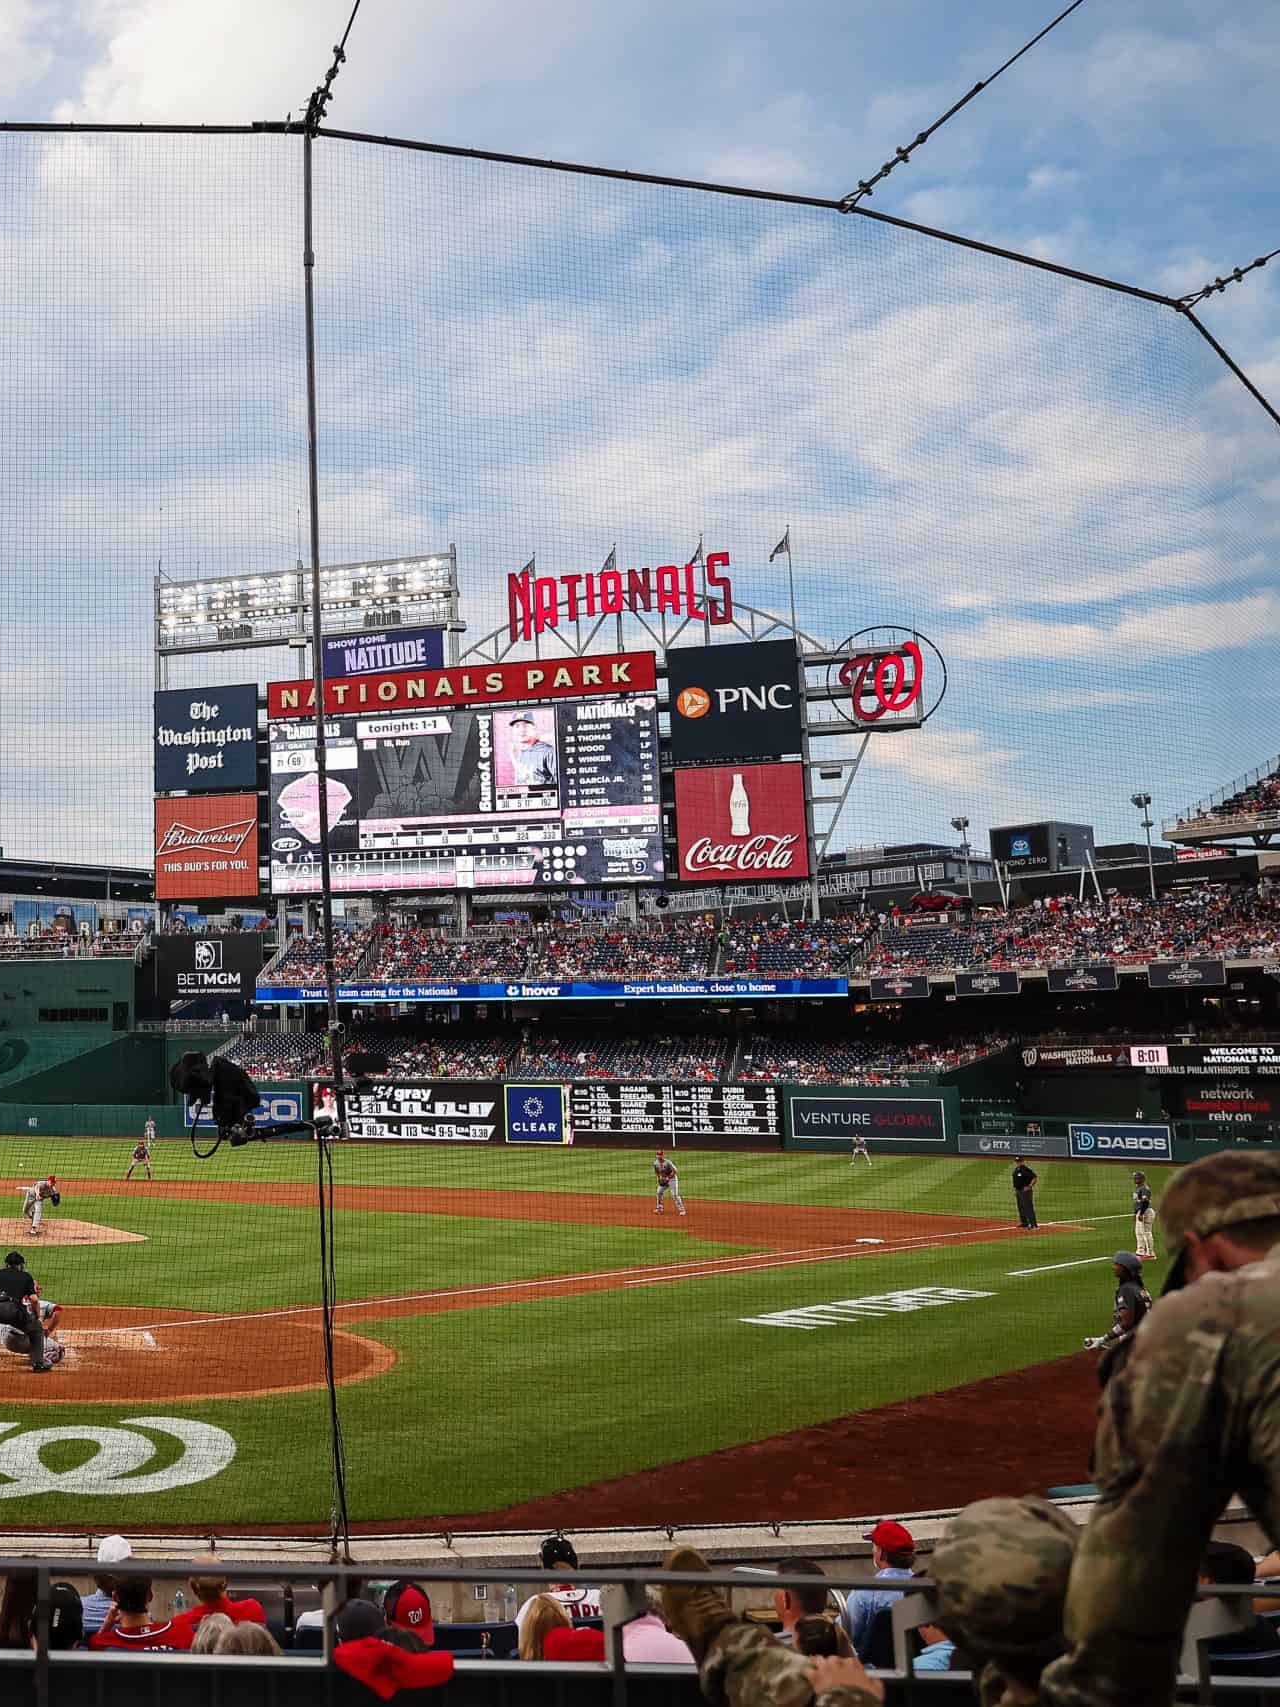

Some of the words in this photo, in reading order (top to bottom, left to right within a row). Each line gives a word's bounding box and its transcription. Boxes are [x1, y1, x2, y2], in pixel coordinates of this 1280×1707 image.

[508, 551, 732, 642] NATIONALS
[327, 637, 358, 650] SHOW
[359, 633, 387, 645] SOME
[344, 638, 426, 672] NATITUDE
[281, 675, 504, 709] NATIONALS
[527, 662, 632, 689] PARK
[720, 684, 793, 713] PNC
[189, 702, 220, 721] The
[577, 703, 636, 720] NATIONALS
[287, 722, 341, 740] CARDIALS
[368, 719, 420, 734] tonight:
[157, 726, 253, 748] Washington
[476, 714, 493, 758] jacob
[577, 733, 612, 742] THOMAS
[186, 758, 224, 776] Post
[477, 761, 492, 812] young
[164, 830, 245, 847] Budweiser
[685, 833, 800, 871] Coca-Cola
[163, 862, 183, 873] THIS
[184, 861, 210, 872] BUD'S
[211, 860, 229, 871] FOR
[230, 859, 249, 870] YOU.
[1028, 855, 1048, 866] ZERO
[177, 972, 241, 985] BETMGM
[300, 988, 323, 998] Trust
[338, 989, 359, 998] team
[360, 988, 387, 999] caring
[388, 987, 402, 997] for
[402, 986, 417, 997] the
[418, 986, 458, 997] Nationals
[522, 985, 560, 997] Inova
[623, 984, 655, 995] Expert
[656, 983, 709, 994] healthcare,
[710, 982, 732, 993] close
[733, 983, 747, 992] to
[748, 981, 776, 992] home
[1040, 1048, 1095, 1061] WASHINGTON
[1137, 1049, 1161, 1063] 8:01
[1209, 1047, 1259, 1056] WELCOME
[1260, 1047, 1275, 1056] TO
[1065, 1054, 1113, 1066] NATIONALS
[1202, 1055, 1258, 1064] NATIONALS
[1145, 1065, 1186, 1075] NATIONALS
[1187, 1065, 1250, 1075] PHILANTHROPIES
[394, 1088, 432, 1103] gray
[1200, 1088, 1255, 1099] network
[801, 1111, 871, 1125] VENTURE
[874, 1112, 935, 1128] GLOBAL
[1235, 1112, 1253, 1123] on
[512, 1122, 557, 1132] CLEAR
[993, 1140, 1011, 1149] RTX
[1097, 1136, 1168, 1150] DABOS
